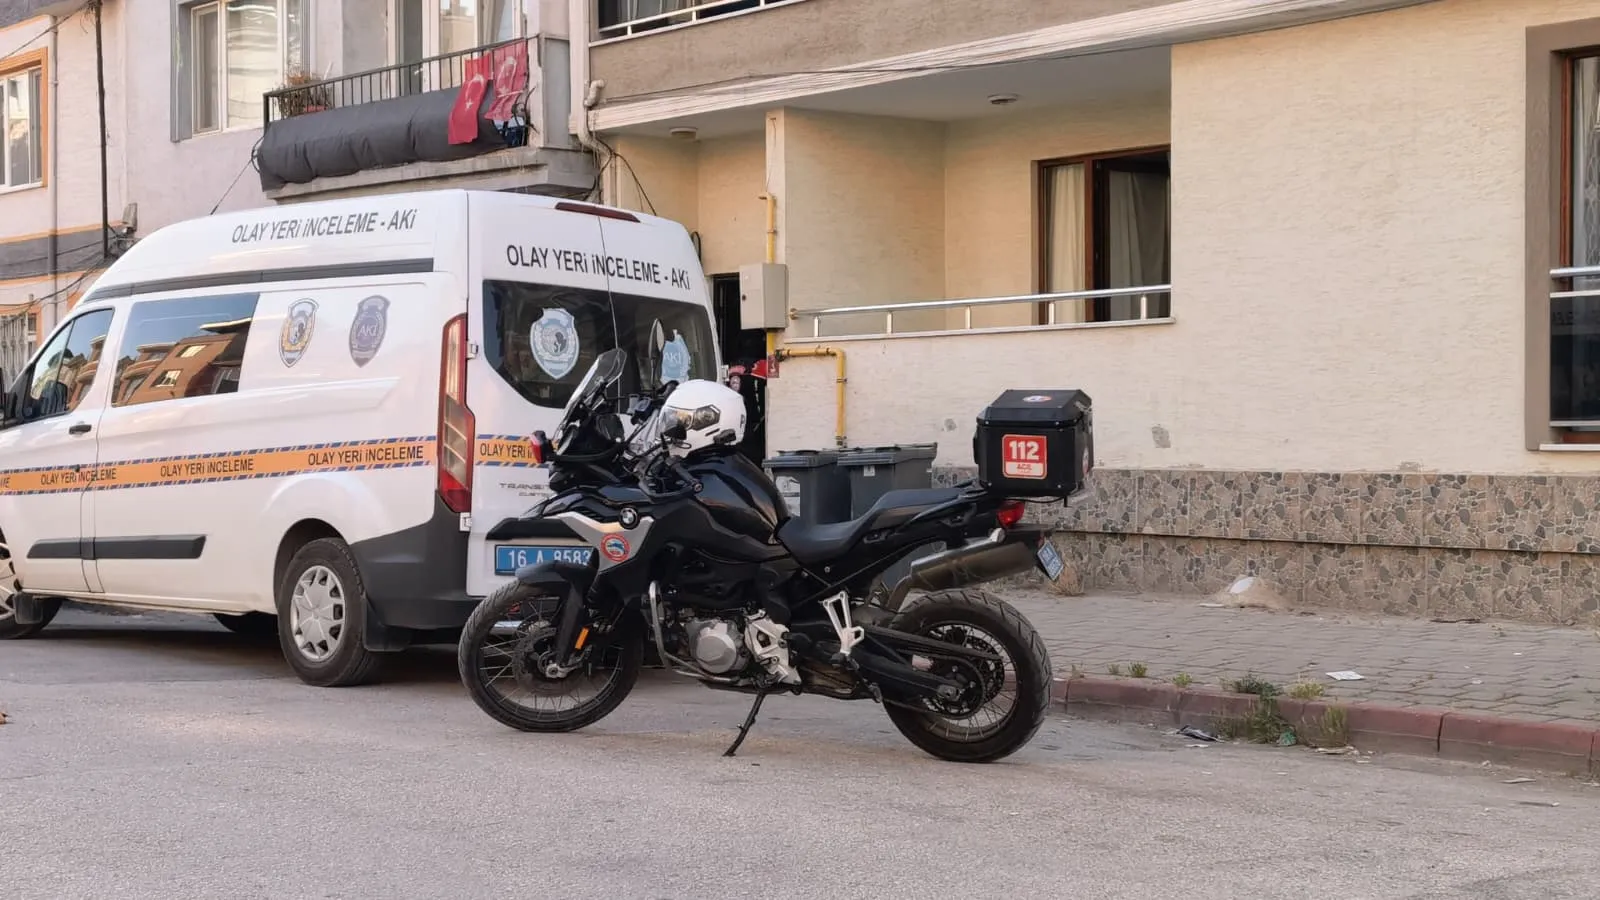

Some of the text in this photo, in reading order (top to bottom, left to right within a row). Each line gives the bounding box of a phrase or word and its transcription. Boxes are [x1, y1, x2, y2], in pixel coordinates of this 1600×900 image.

[232, 222, 269, 243] OLAY
[506, 245, 548, 268] OLAY
[308, 451, 335, 466] OLAY
[480, 443, 504, 457] OLAY
[1009, 440, 1040, 460] 112
[40, 474, 60, 485] OLAY
[160, 465, 183, 477] OLAY
[508, 550, 527, 569] 16
[536, 550, 544, 564] A
